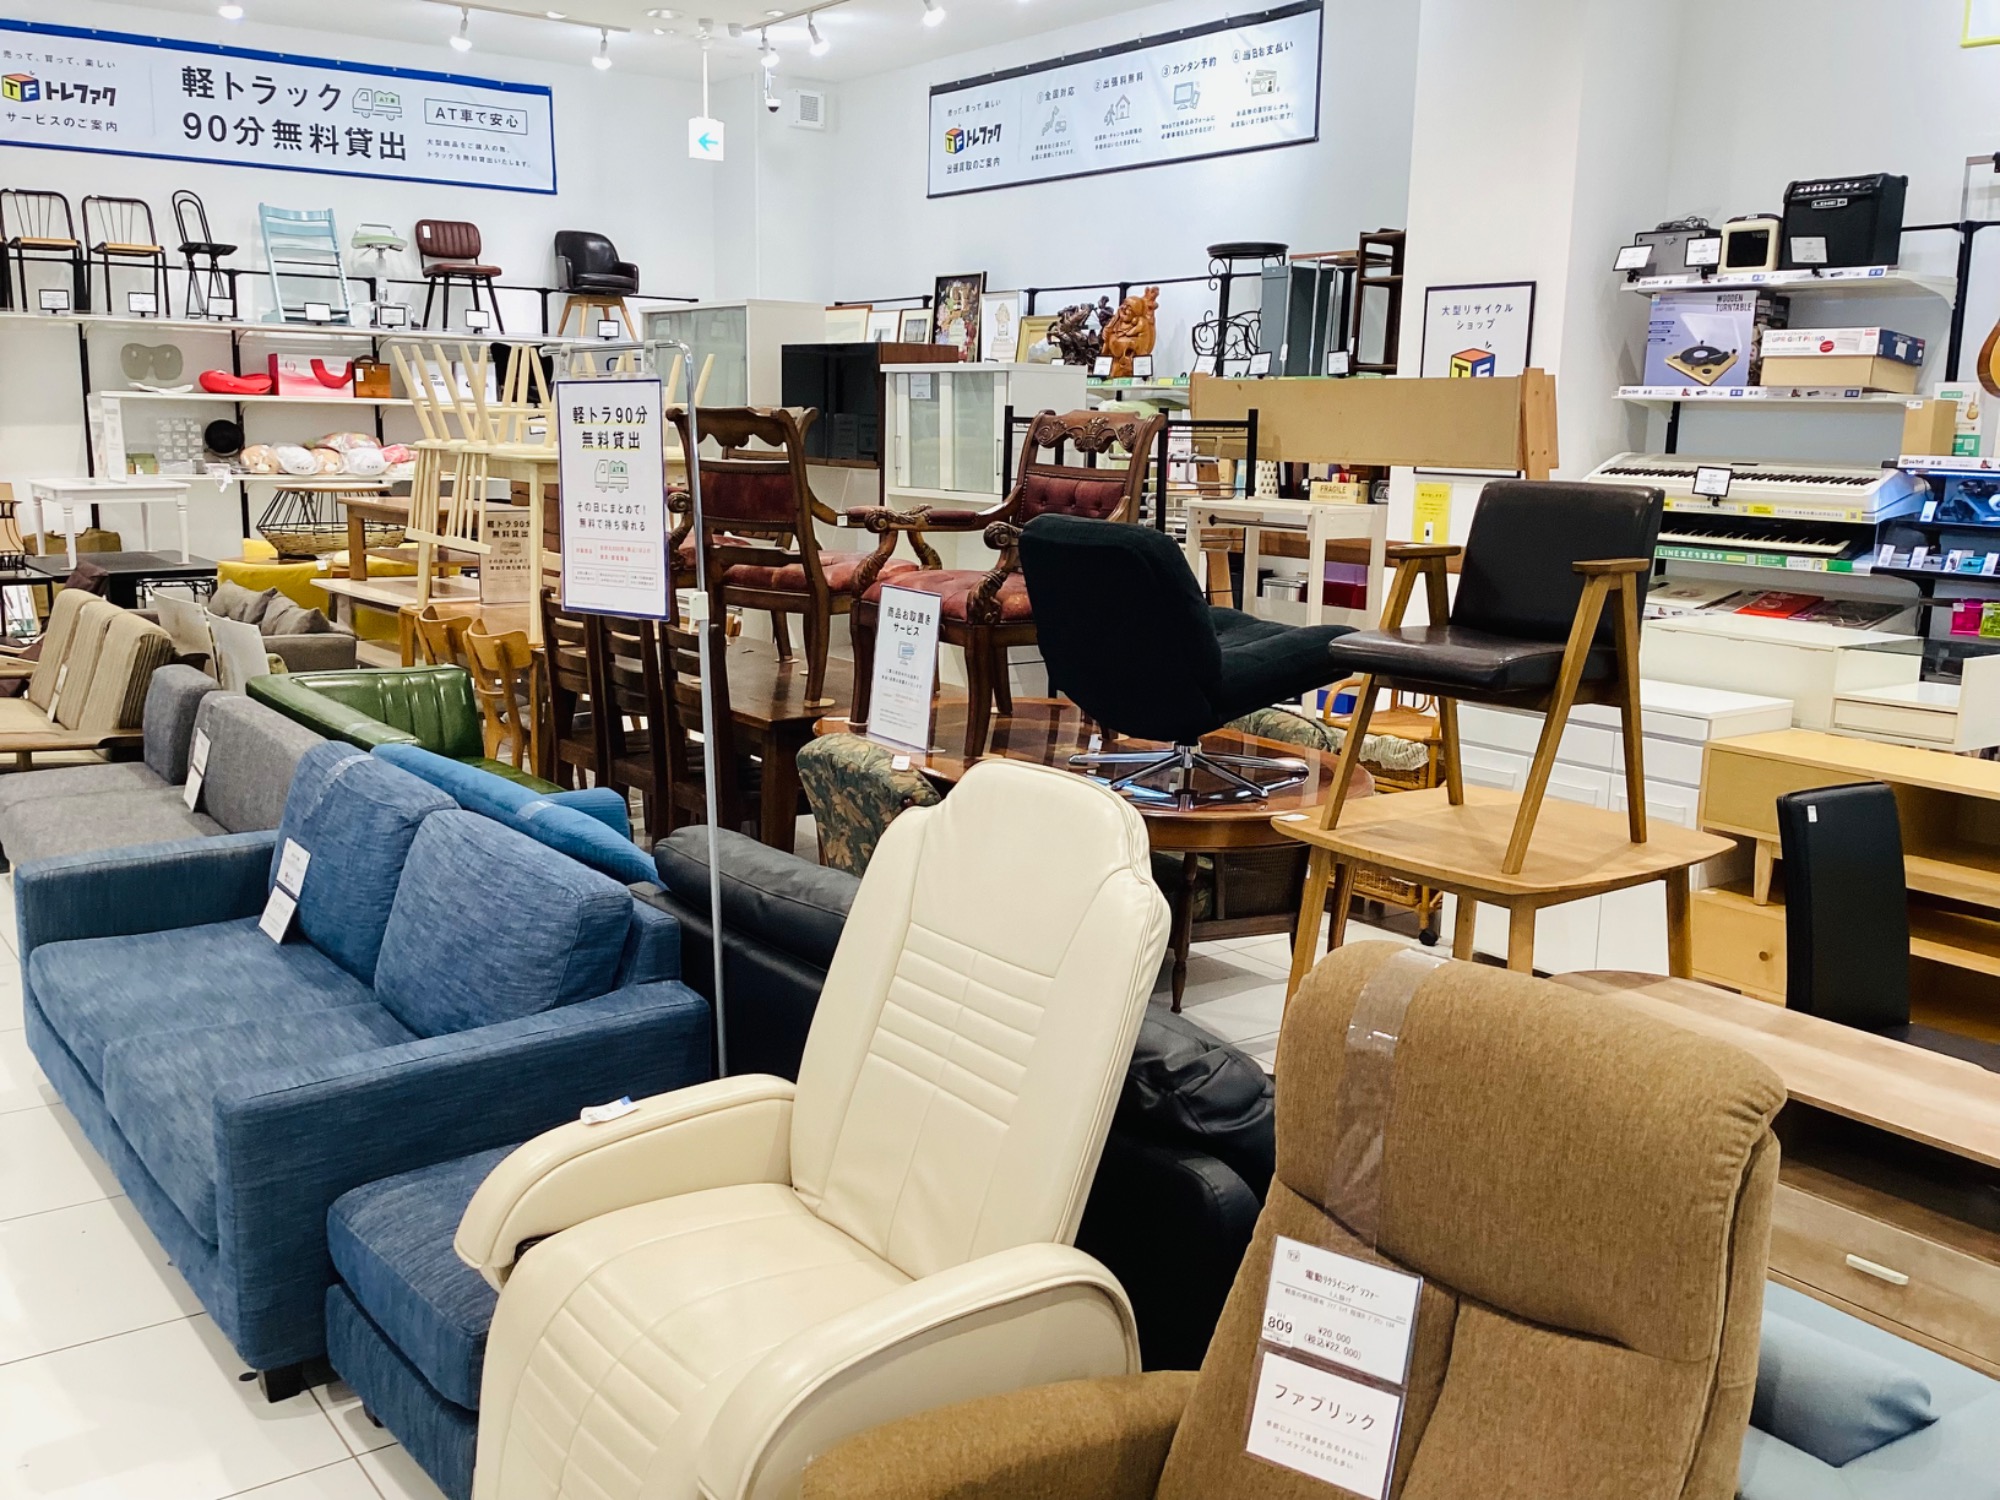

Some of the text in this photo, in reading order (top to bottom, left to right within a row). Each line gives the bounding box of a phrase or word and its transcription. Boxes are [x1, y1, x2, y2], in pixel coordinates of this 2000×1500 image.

[1242, 41, 1294, 61] 当日お支払い
[1173, 56, 1217, 75] カンタン予約
[45, 81, 116, 107] トレファク
[182, 65, 342, 112] 軽トラック
[6, 111, 118, 132] サービスのご案内
[435, 106, 519, 128] AT車で安心
[183, 112, 407, 161] 90分無料貸出
[966, 124, 1002, 148] トレファク
[1716, 293, 1744, 302] WOODEN
[1716, 302, 1752, 312] TURNTABLE
[1441, 304, 1514, 316] 大型リサイクル
[1456, 318, 1496, 330] ショップ
[572, 405, 648, 424] 軽トラ90分
[581, 430, 641, 450] 無料貸出
[1320, 485, 1347, 494] FRAGILE
[578, 517, 647, 532] 無料で持ち帰れる
[893, 623, 920, 636] サービス
[1267, 1315, 1293, 1334] 809
[1274, 1383, 1376, 1431] ファブリック
